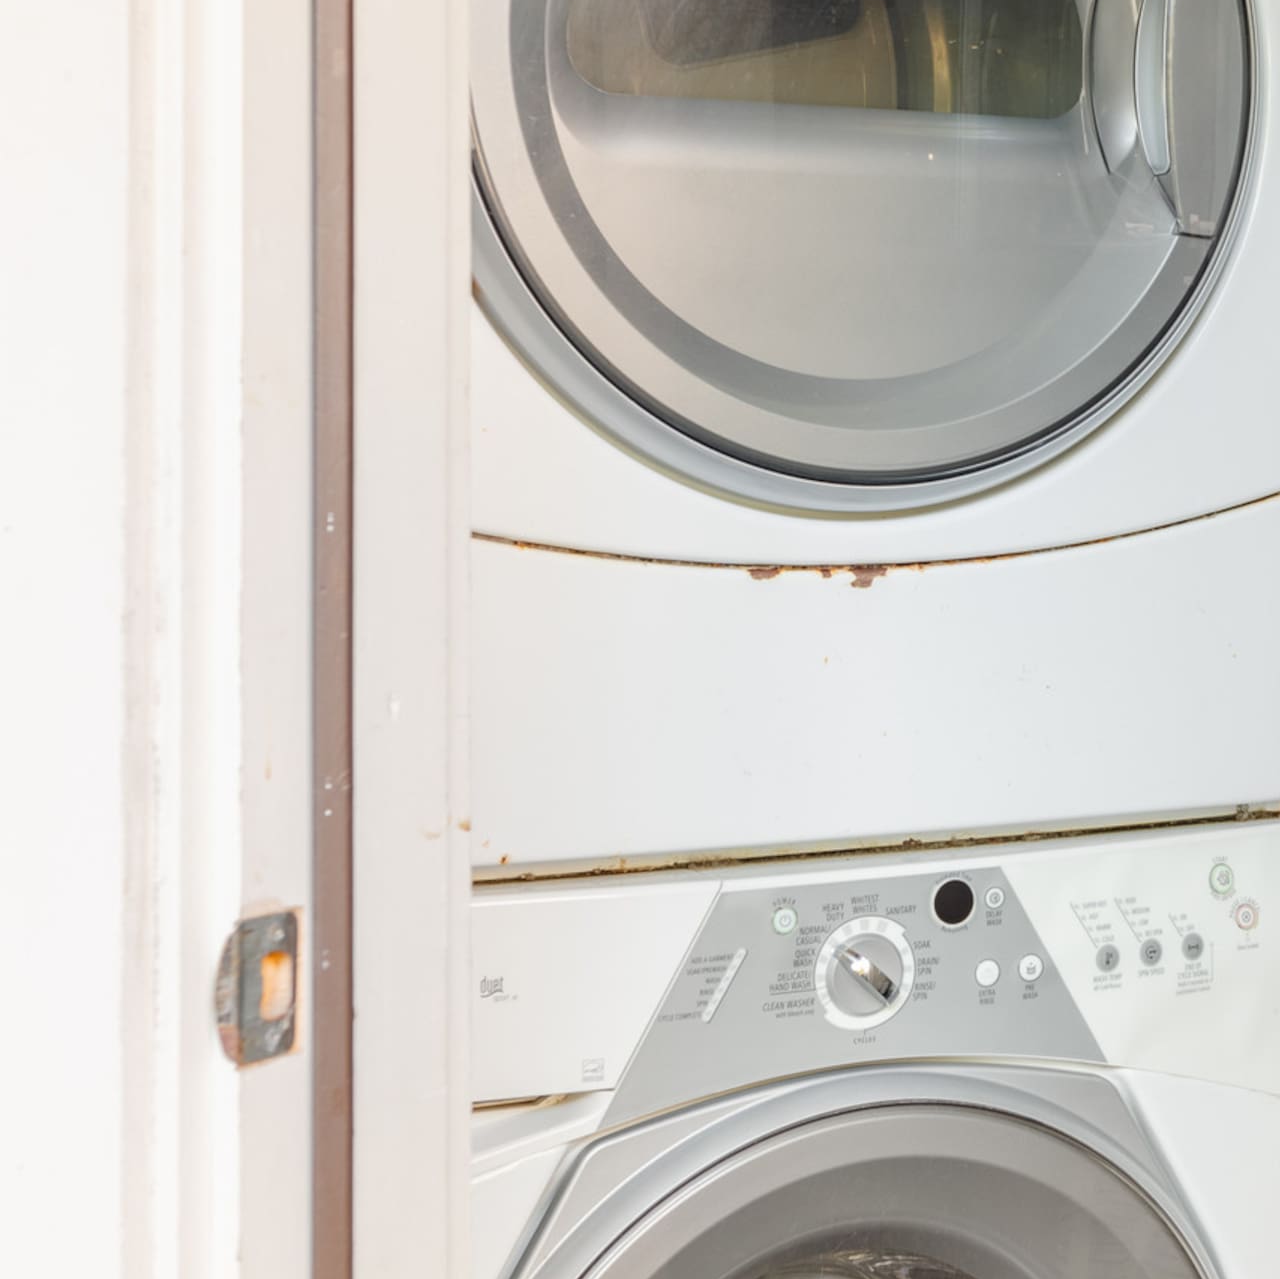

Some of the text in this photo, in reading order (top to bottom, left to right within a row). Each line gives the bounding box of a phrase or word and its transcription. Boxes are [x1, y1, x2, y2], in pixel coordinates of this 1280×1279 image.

[851, 894, 879, 905] WHITEST
[822, 904, 845, 912] HEAVY
[853, 905, 878, 915] WHITES
[885, 905, 917, 916] SANITARY
[826, 912, 845, 922] DUTY
[796, 936, 821, 946] CASUAL
[914, 940, 931, 949] SOAK
[794, 948, 816, 958] QUICK
[793, 958, 813, 968] WASH
[917, 967, 932, 976] SPIN
[769, 980, 812, 993] HAND WASH
[913, 991, 928, 1001] SPIN
[762, 998, 815, 1012] CLEAN WASHER
